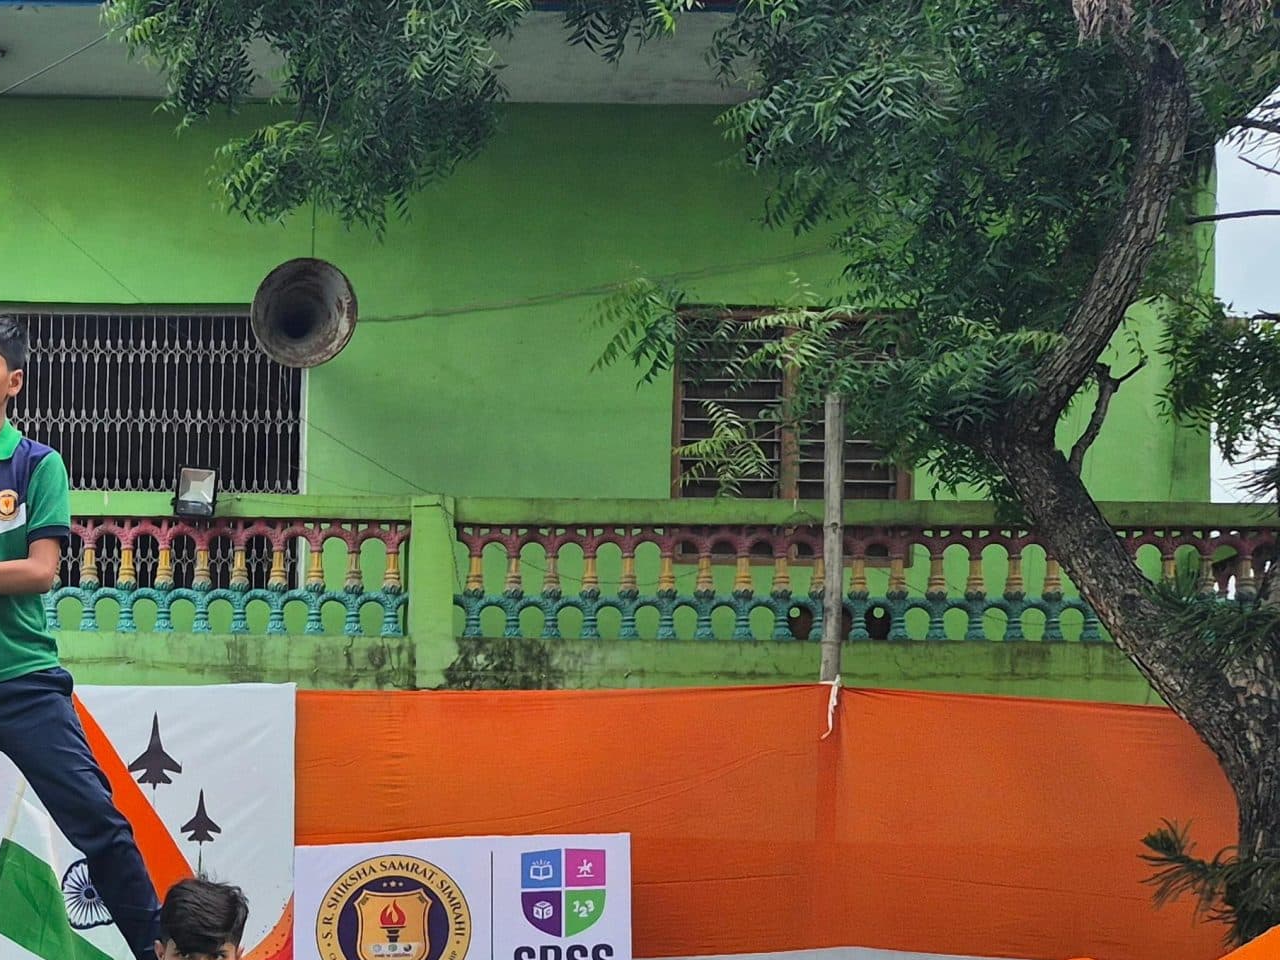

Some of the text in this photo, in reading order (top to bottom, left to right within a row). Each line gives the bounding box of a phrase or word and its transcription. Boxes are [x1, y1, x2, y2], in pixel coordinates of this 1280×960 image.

[322, 860, 466, 940] S. R. SHIKSHA SAMRAT, SIMRAHI
